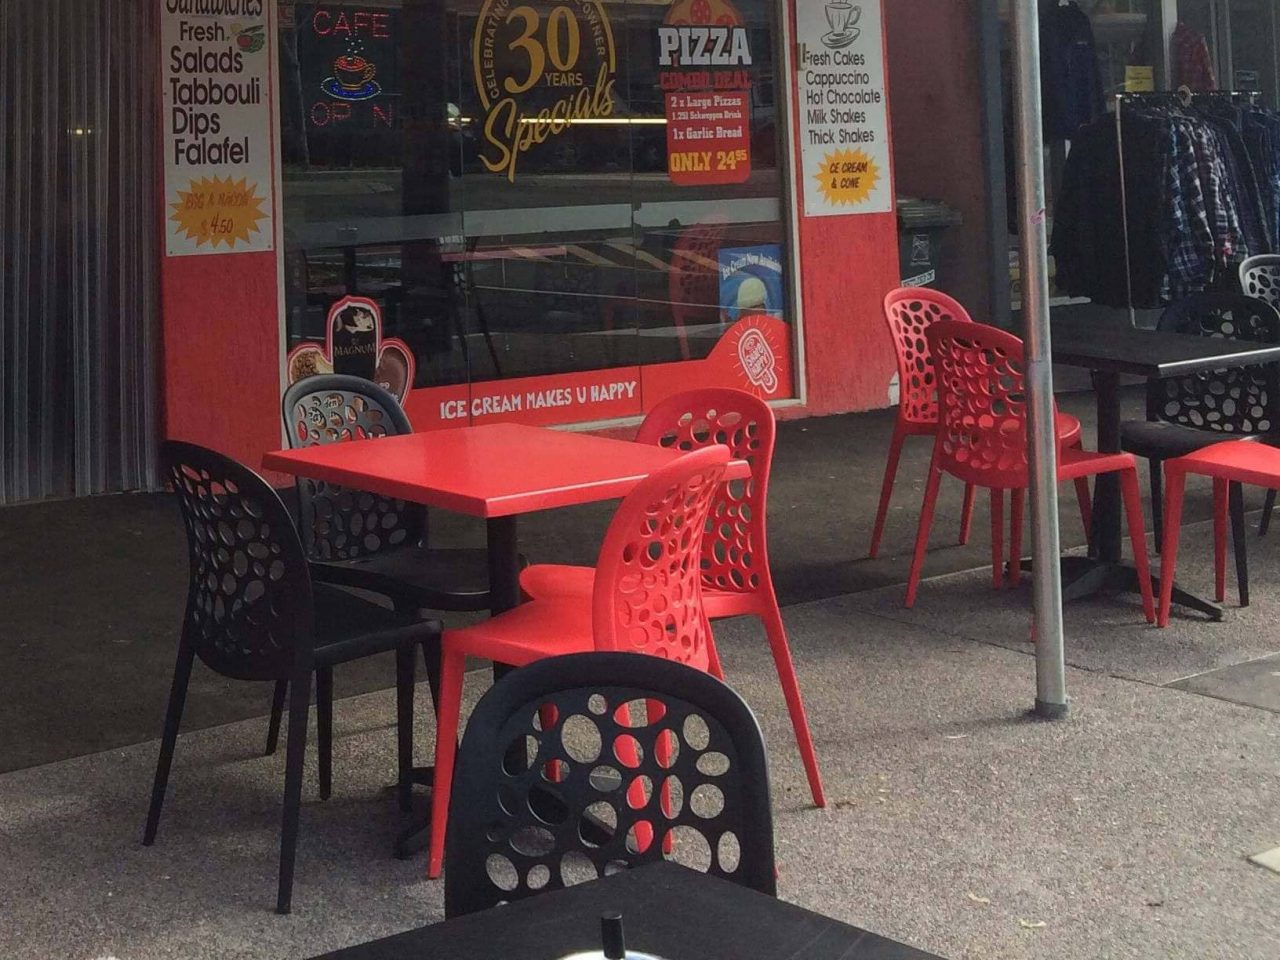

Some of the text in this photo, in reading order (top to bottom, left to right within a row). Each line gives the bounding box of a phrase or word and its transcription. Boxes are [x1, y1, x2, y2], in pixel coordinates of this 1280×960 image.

[180, 21, 225, 41] Fresh
[313, 9, 390, 38] CAFE
[582, 5, 607, 56] OWNER
[504, 5, 581, 94] 30
[658, 27, 752, 66] PIZZA
[170, 45, 243, 73] Salads
[833, 51, 865, 66] Cakes
[545, 72, 584, 87] YEARS
[806, 70, 869, 87] Cappuccino
[170, 77, 260, 105] Tabbouli
[807, 88, 881, 105] Hot Chocolate
[671, 96, 677, 107] 2
[687, 96, 712, 109] Large
[713, 95, 741, 107] Pizzas
[173, 107, 220, 140] Dips
[310, 100, 393, 129] OPN
[477, 61, 616, 184] Specials
[807, 108, 866, 125] Milk Shakes
[686, 126, 714, 139] Garlic
[716, 125, 742, 138] Bread
[809, 128, 874, 145] Thick Shakes
[175, 136, 249, 165] Falafel
[671, 151, 712, 172] ONLY
[842, 161, 867, 173] CREAM
[840, 176, 860, 188] CONE
[334, 343, 376, 357] MAGNUM
[440, 381, 637, 419] ICE CREAM MAKES U HAPPY
